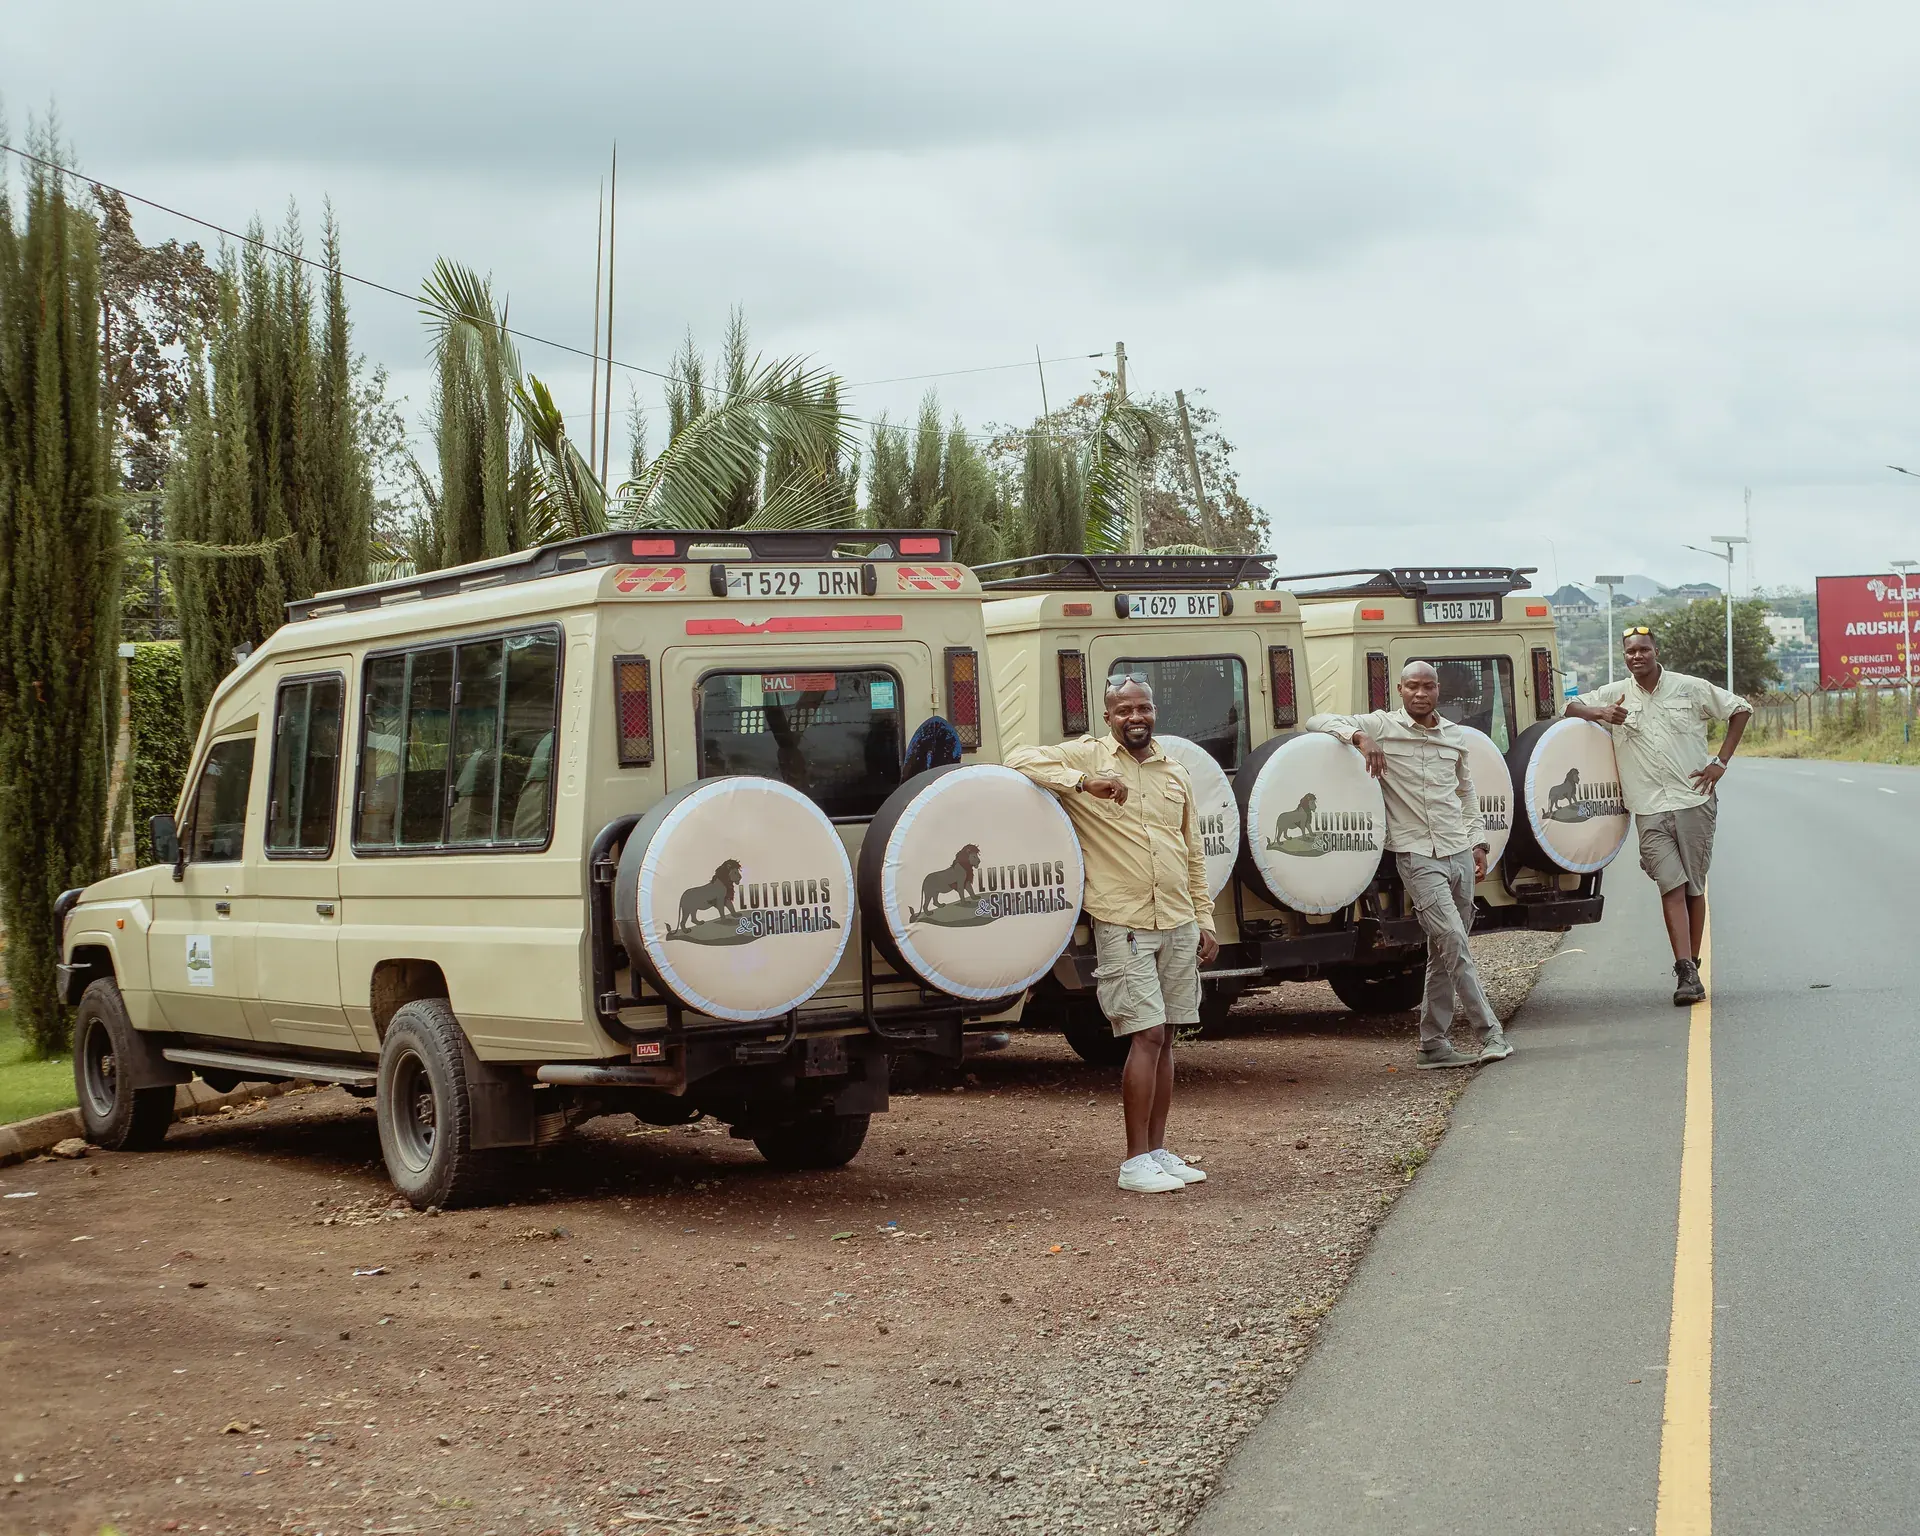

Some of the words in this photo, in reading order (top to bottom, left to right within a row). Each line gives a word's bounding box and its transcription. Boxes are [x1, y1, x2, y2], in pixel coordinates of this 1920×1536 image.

[741, 572, 753, 595] T
[760, 572, 800, 595] 529
[818, 571, 859, 595] DRN
[1139, 597, 1147, 615] T
[1150, 596, 1177, 615] 629
[1187, 596, 1216, 614] BXF
[1432, 603, 1439, 619] T
[1442, 603, 1463, 619] 503
[1845, 620, 1910, 636] ARUSHA
[1896, 642, 1918, 651] DALY
[1849, 654, 1893, 664] SERENGETI
[1861, 665, 1901, 675] ZANZIBAR
[764, 677, 792, 690] HAL
[1477, 795, 1506, 813] OURS
[1315, 811, 1373, 831] LUITOURS
[977, 860, 1065, 892] LUITOURS
[738, 878, 831, 910] LUITOURS
[640, 1045, 658, 1054] HAL
